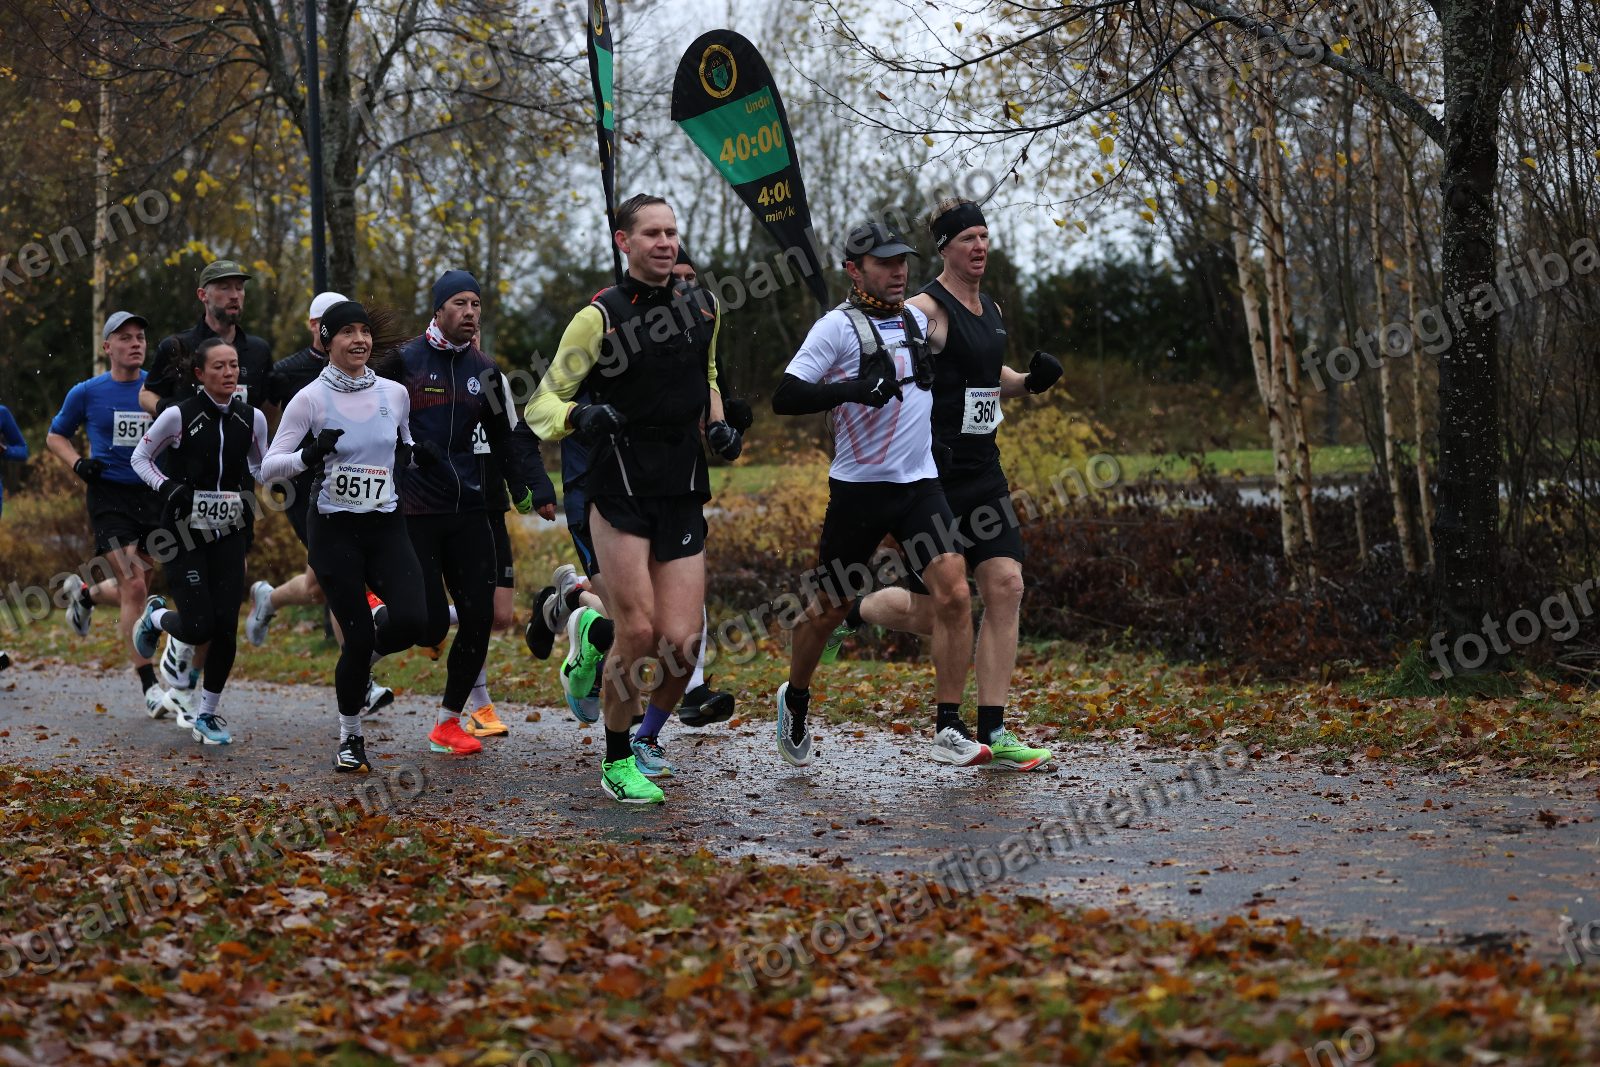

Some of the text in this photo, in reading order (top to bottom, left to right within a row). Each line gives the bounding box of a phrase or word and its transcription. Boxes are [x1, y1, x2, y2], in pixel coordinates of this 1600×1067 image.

[719, 120, 783, 165] 40:00
[973, 401, 995, 423] 360
[335, 474, 386, 500] 9517
[196, 500, 239, 521] 9495
